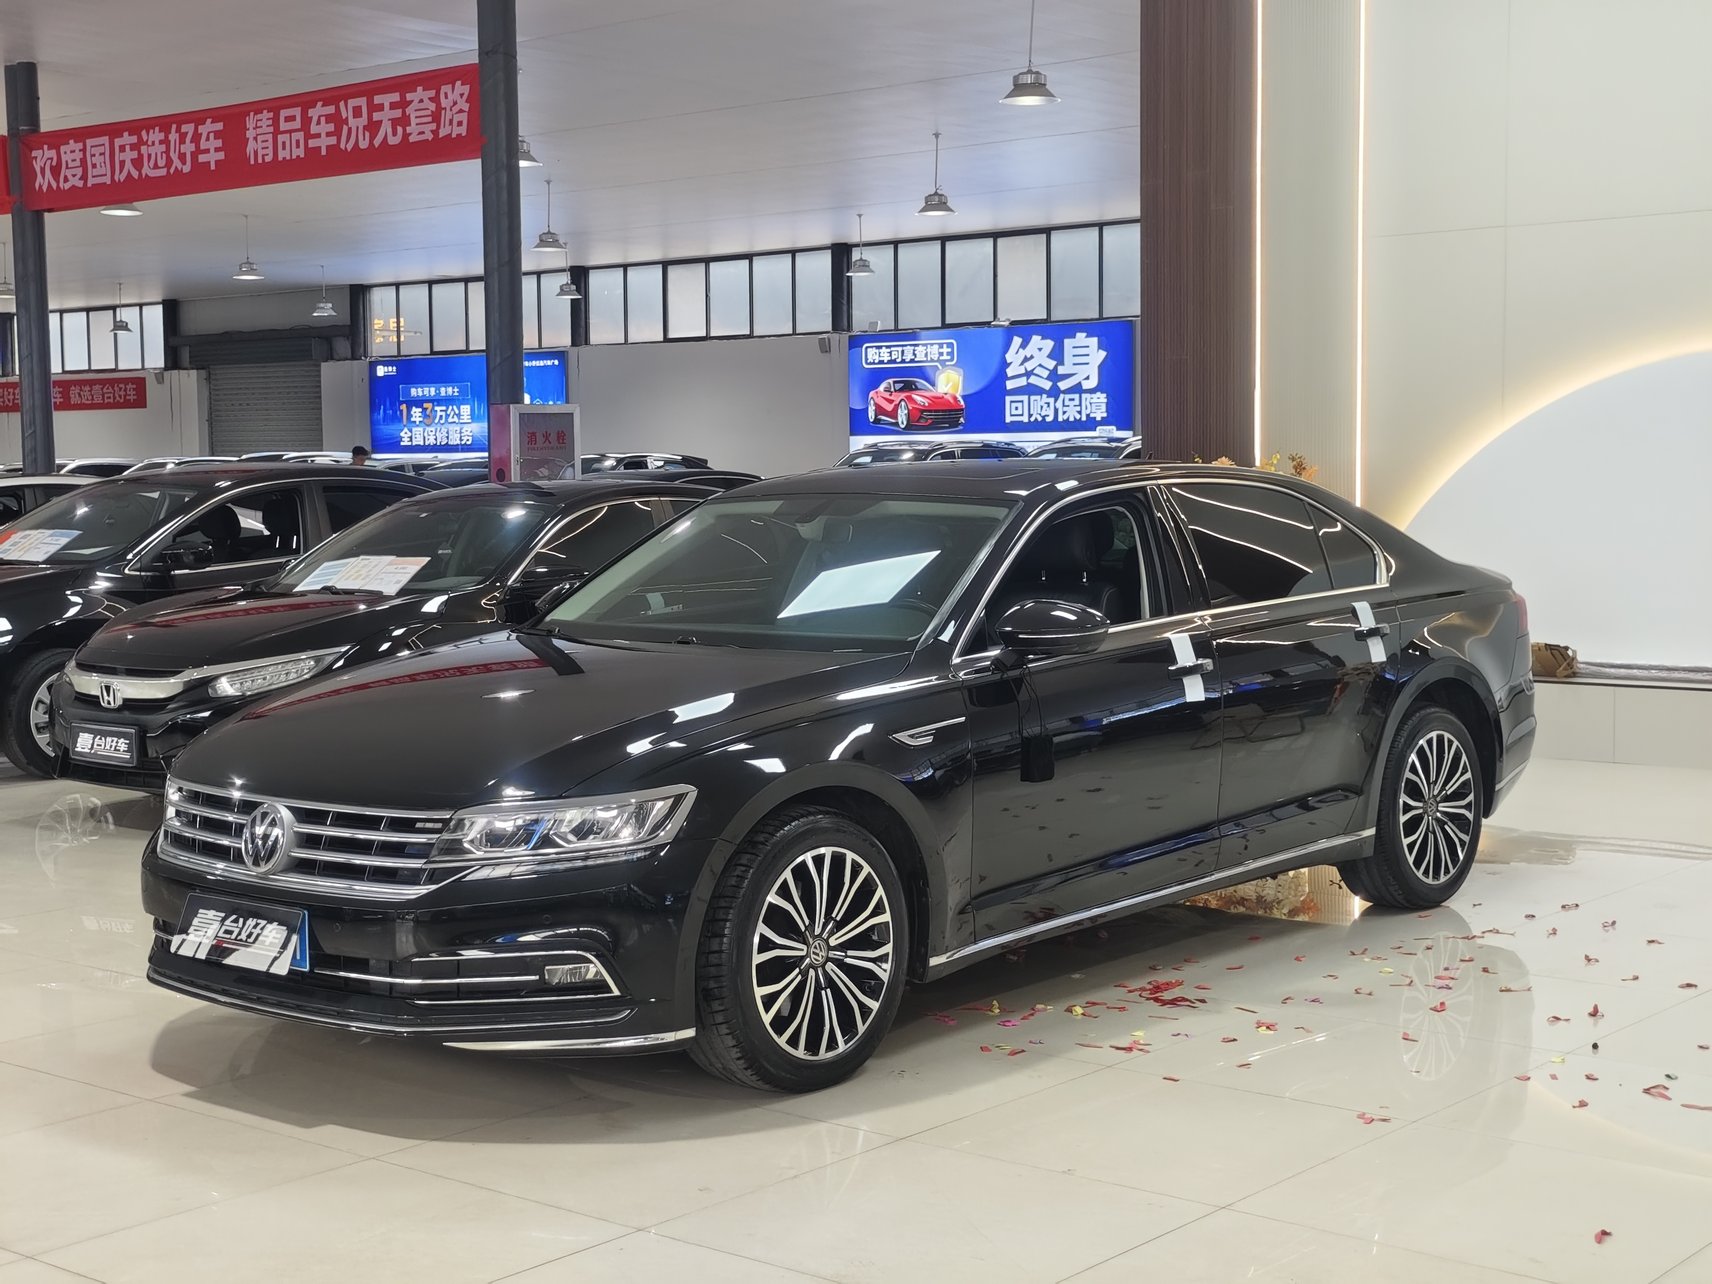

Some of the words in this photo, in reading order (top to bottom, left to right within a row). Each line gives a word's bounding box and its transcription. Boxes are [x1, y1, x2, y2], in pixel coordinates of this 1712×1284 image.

[31, 118, 225, 193] 欢度国庆选好车
[245, 80, 471, 165] 精品车况无套路
[866, 344, 952, 363] 购车可享查博士
[1005, 332, 1107, 391] 终身
[69, 383, 138, 404] 就选壹台好车
[1005, 392, 1108, 423] 回购保障
[399, 427, 473, 446] 全国保修服务
[527, 430, 567, 446] 消火栓
[75, 732, 130, 753] 壹台好车
[186, 908, 289, 946] 壹台好车
